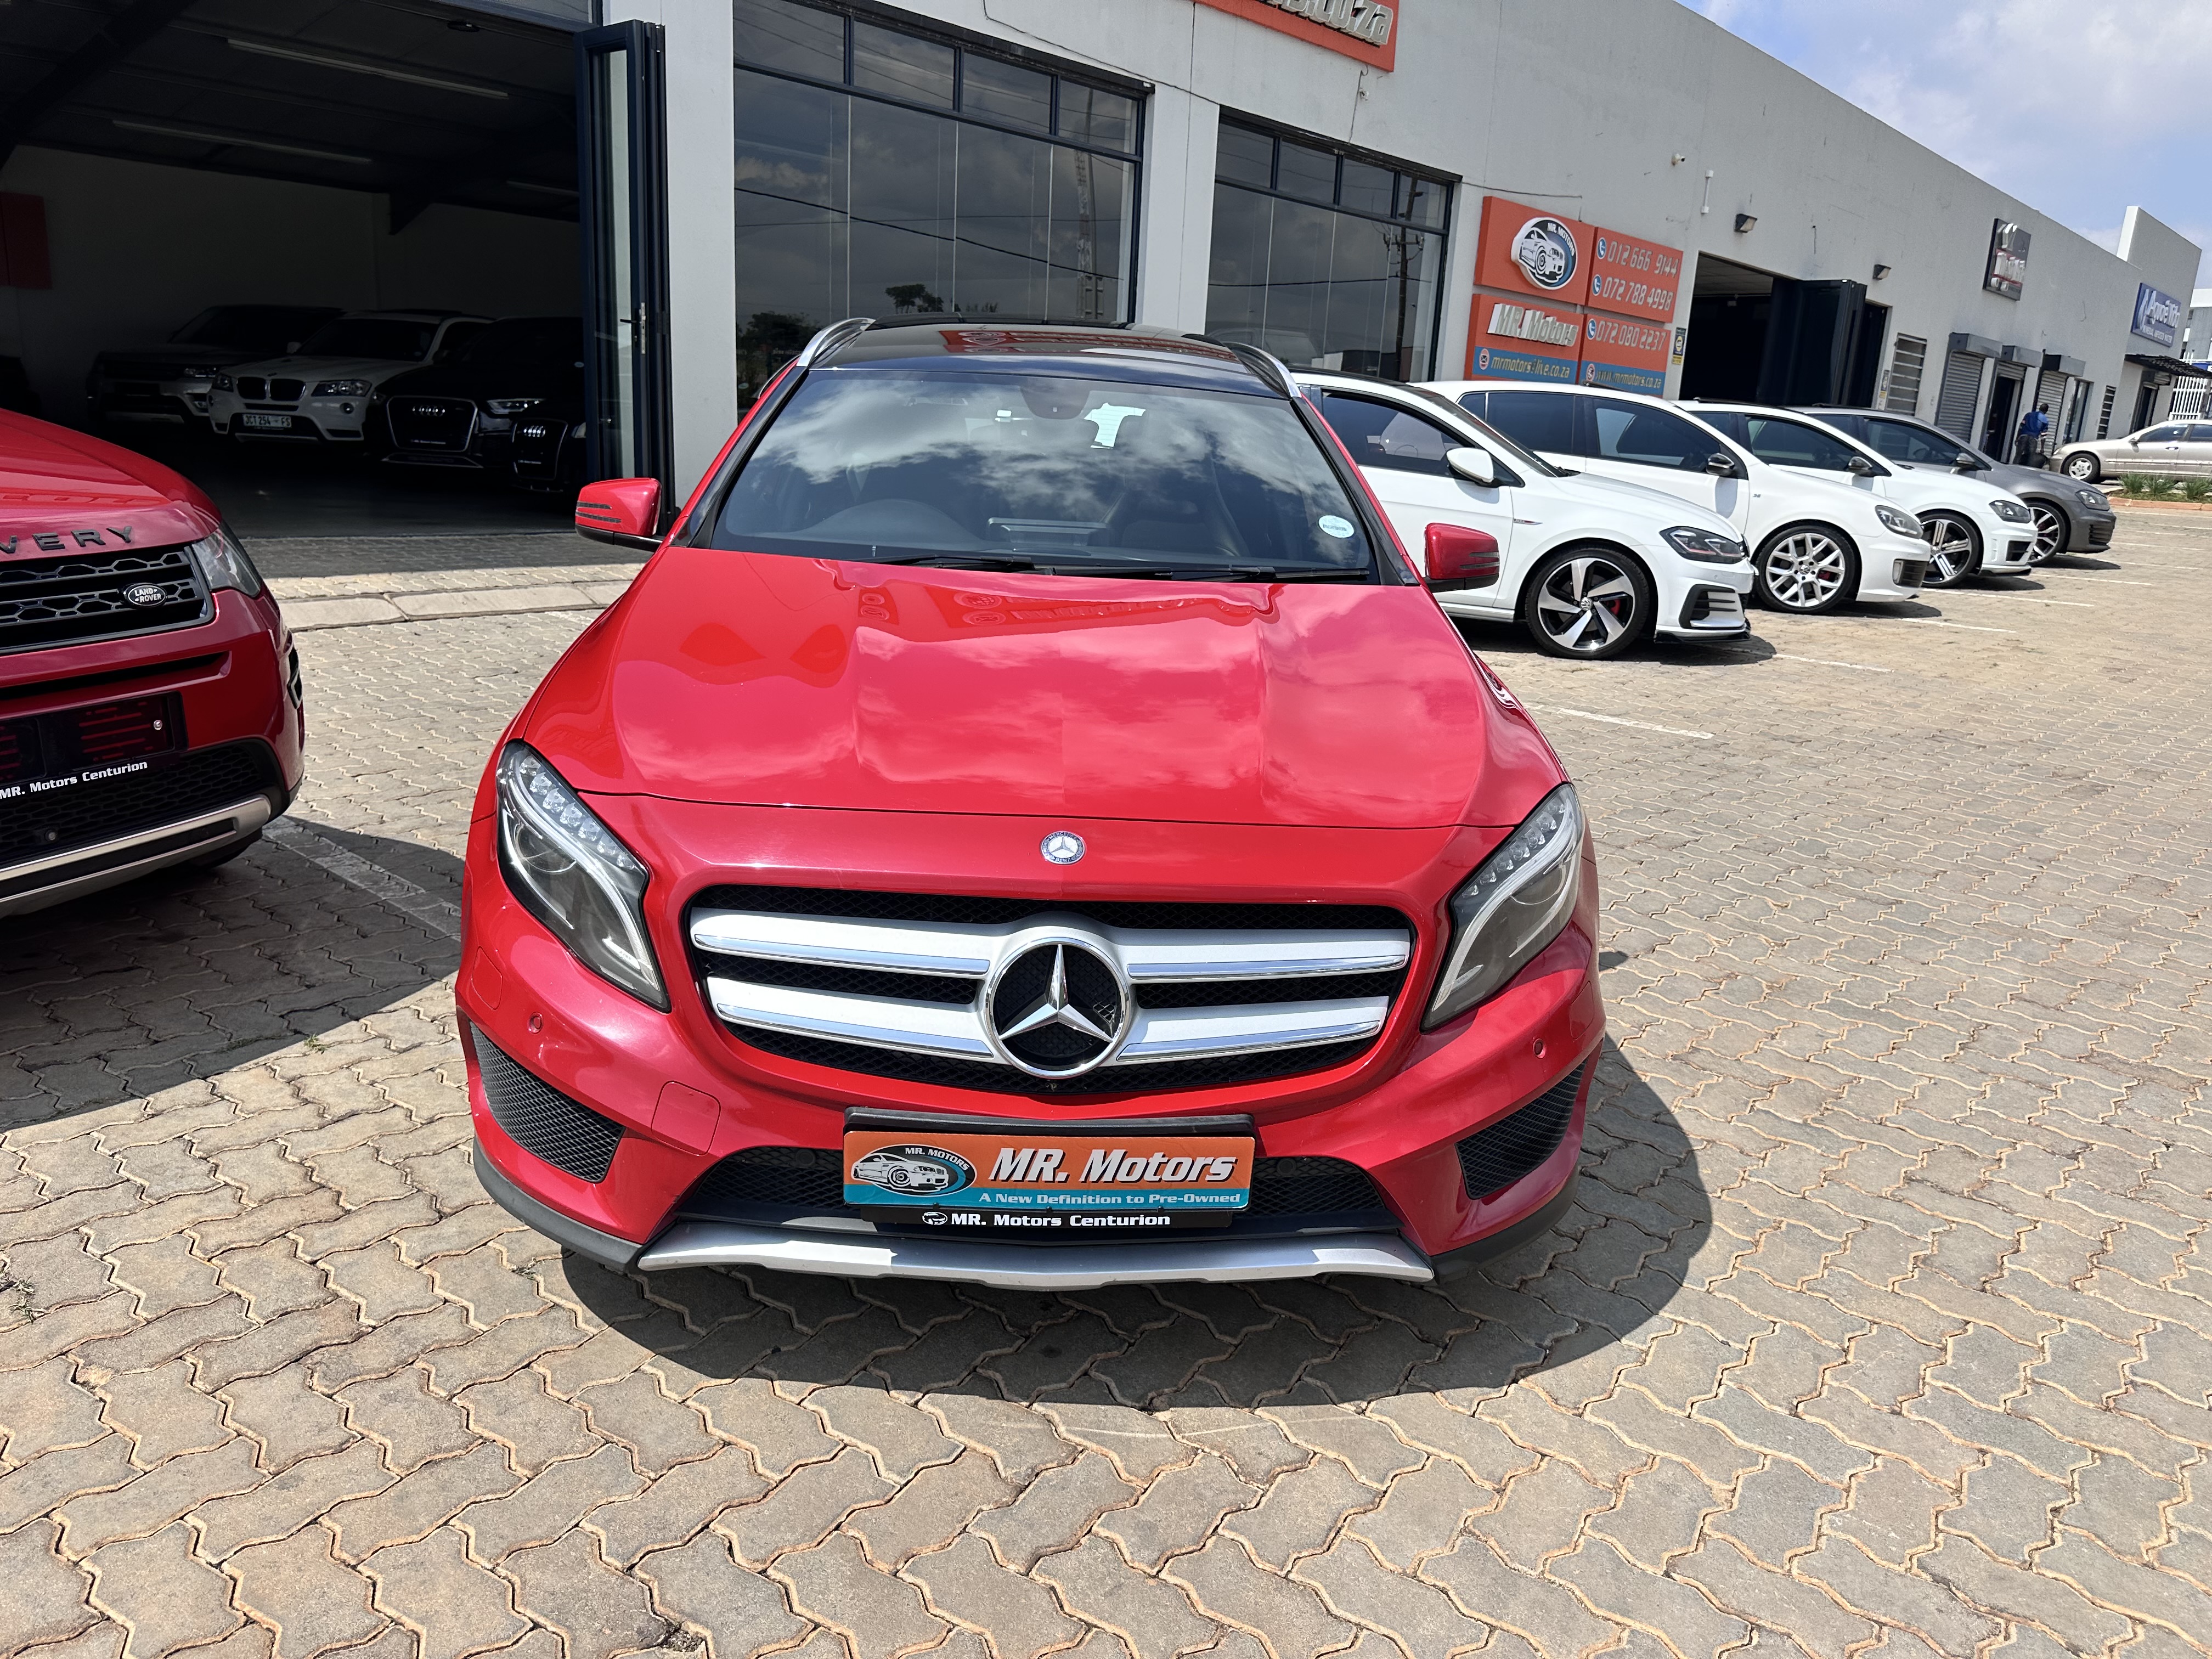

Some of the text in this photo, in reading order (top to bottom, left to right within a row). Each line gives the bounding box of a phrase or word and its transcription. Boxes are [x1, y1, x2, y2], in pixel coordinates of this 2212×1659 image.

[1558, 226, 1575, 256] MOTORS
[1607, 240, 1679, 278] 012 666 9144
[1602, 276, 1674, 311] 072 788 4998
[1522, 310, 1579, 347] Motors
[1596, 320, 1619, 344] 072
[1618, 325, 1640, 347] 080
[1639, 329, 1667, 351] 2237
[134, 588, 154, 596] LAND
[139, 594, 162, 603] ROVER
[0, 761, 148, 799] MR. Motors Centurion
[928, 1149, 970, 1171] MOTORS
[988, 1148, 1238, 1183] MR. Motors
[979, 1193, 1240, 1204] A New Definition to Pre-Owned
[951, 1213, 1170, 1227] MR. Motors Centurion
